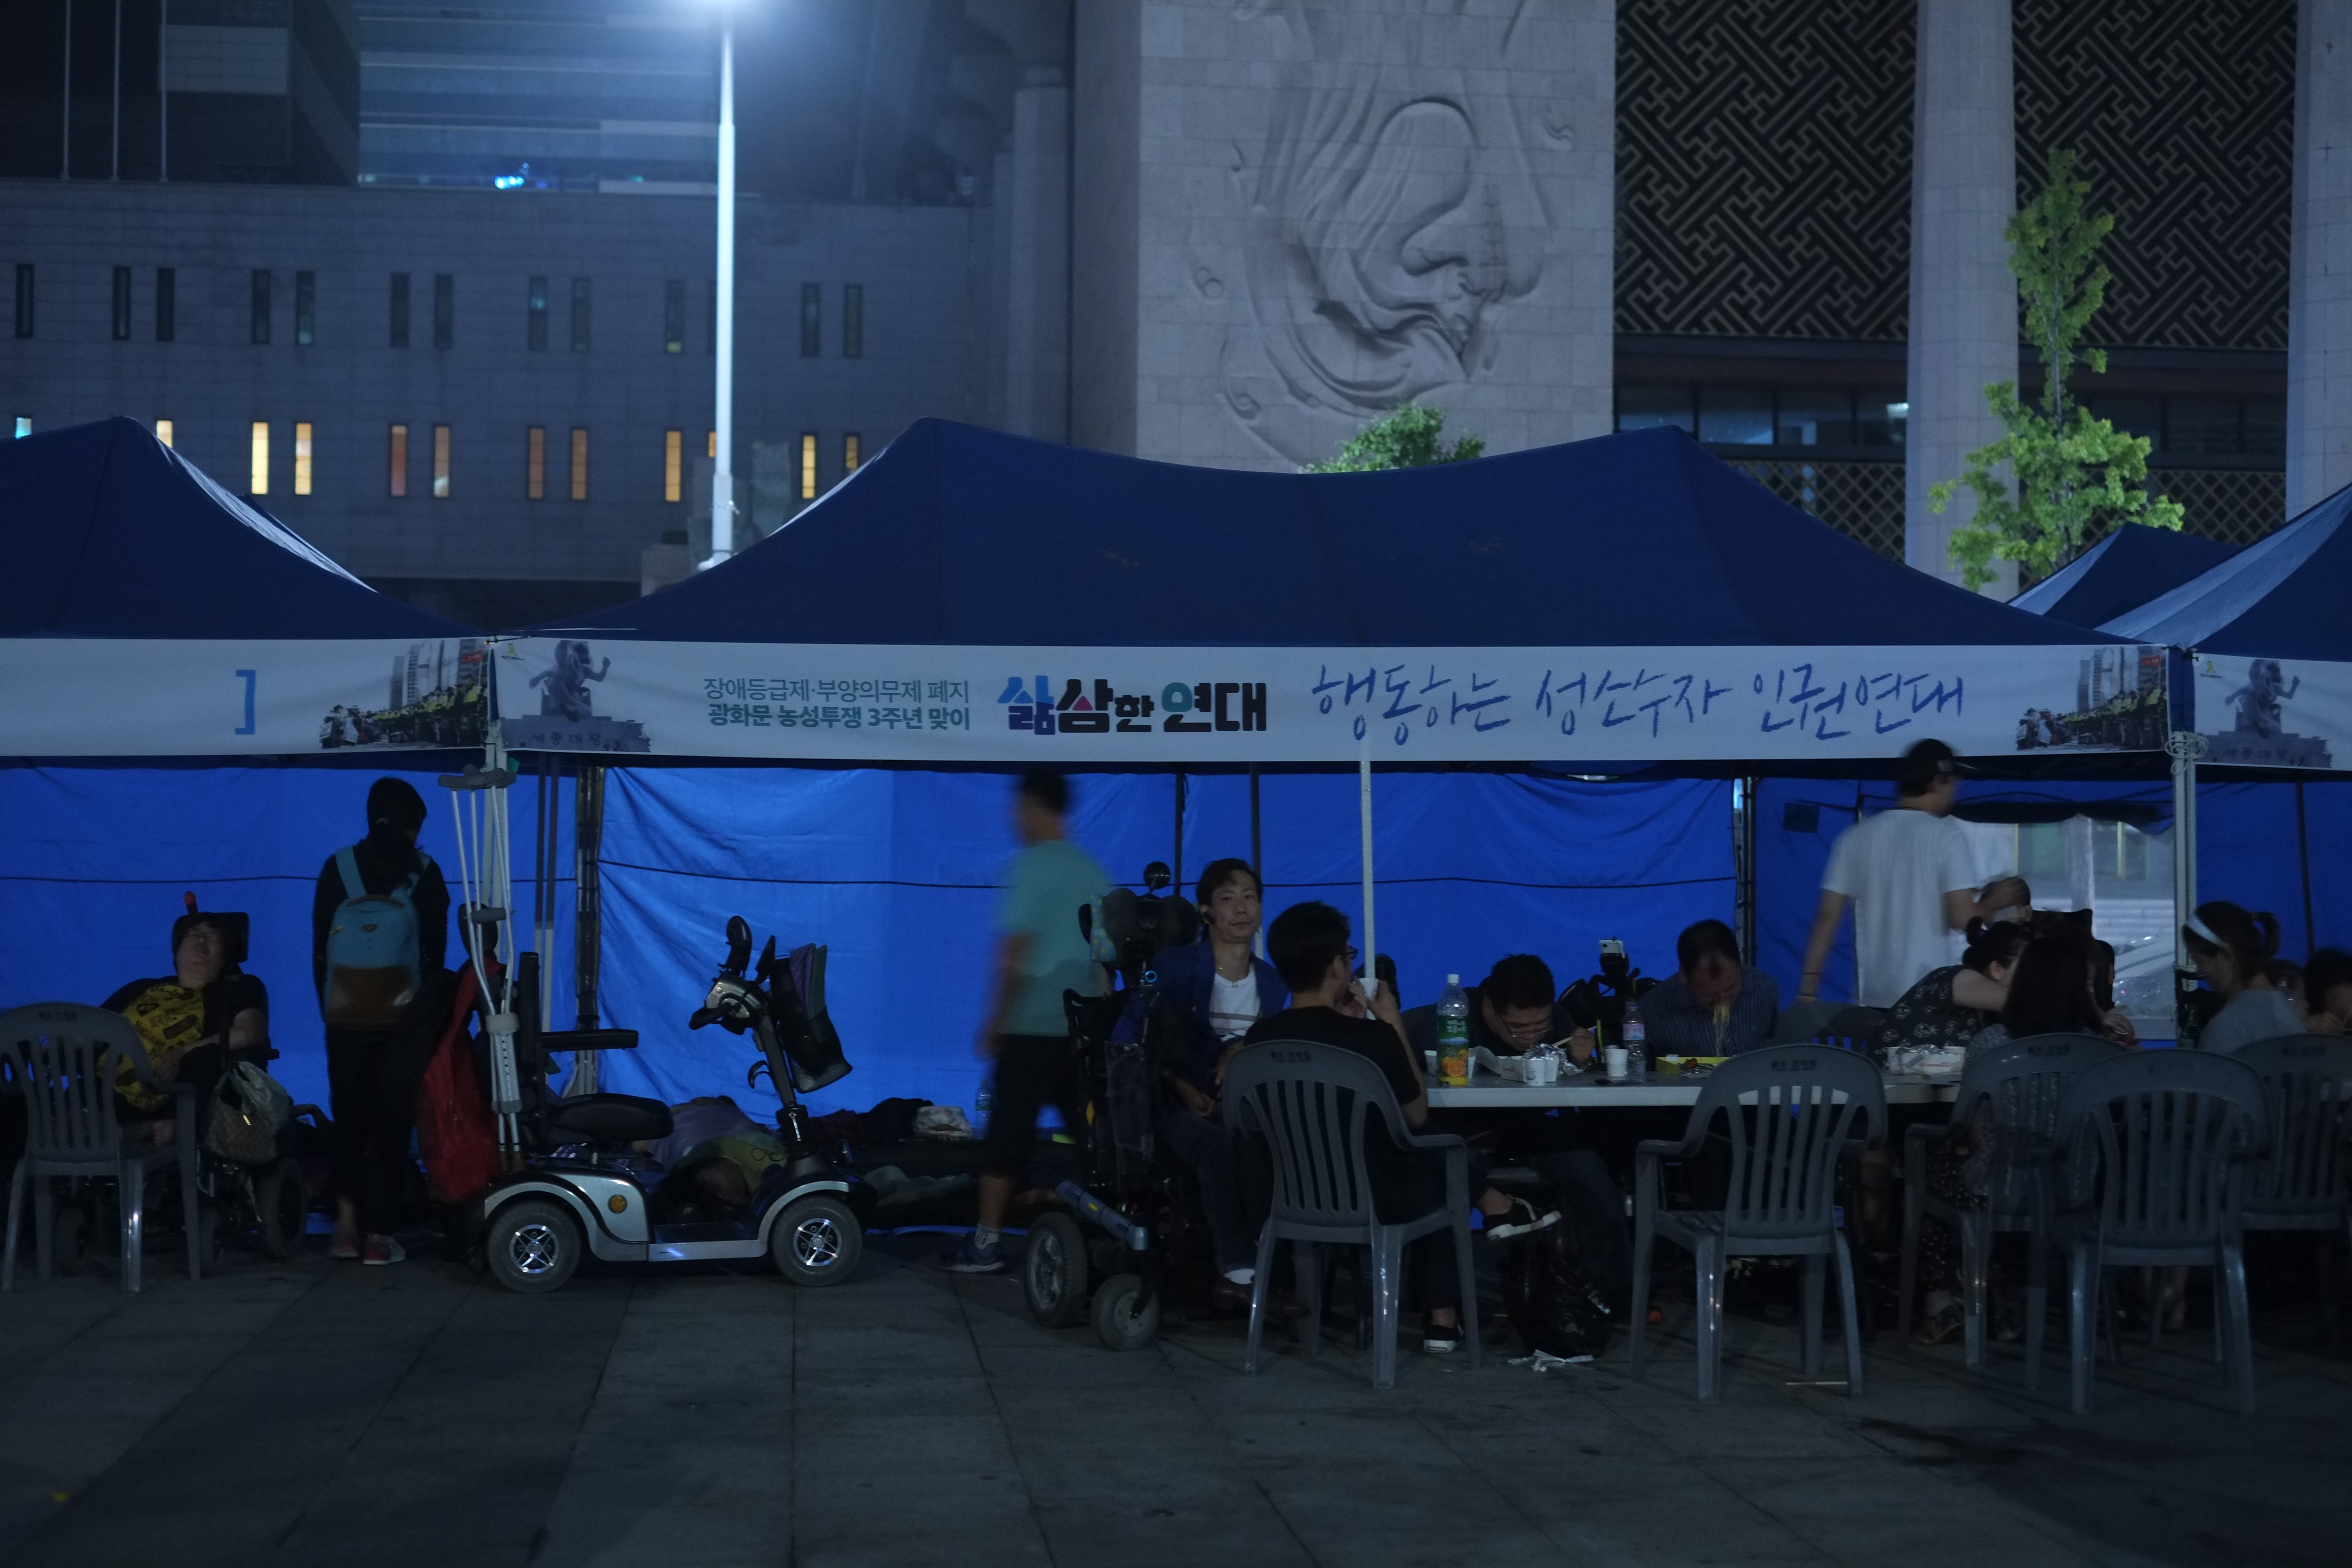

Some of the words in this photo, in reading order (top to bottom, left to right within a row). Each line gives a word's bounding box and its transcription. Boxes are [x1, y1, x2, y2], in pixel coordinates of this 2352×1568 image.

[704, 678, 921, 703] 장애등급제·부양의무제
[928, 680, 969, 703] 폐지
[708, 703, 772, 726] 광화문
[778, 706, 861, 728] 농성투쟁
[868, 707, 922, 730] 3주년
[928, 707, 969, 730] 맞이
[1311, 664, 1511, 746] 행동하는
[1536, 669, 1733, 737] 성소수자
